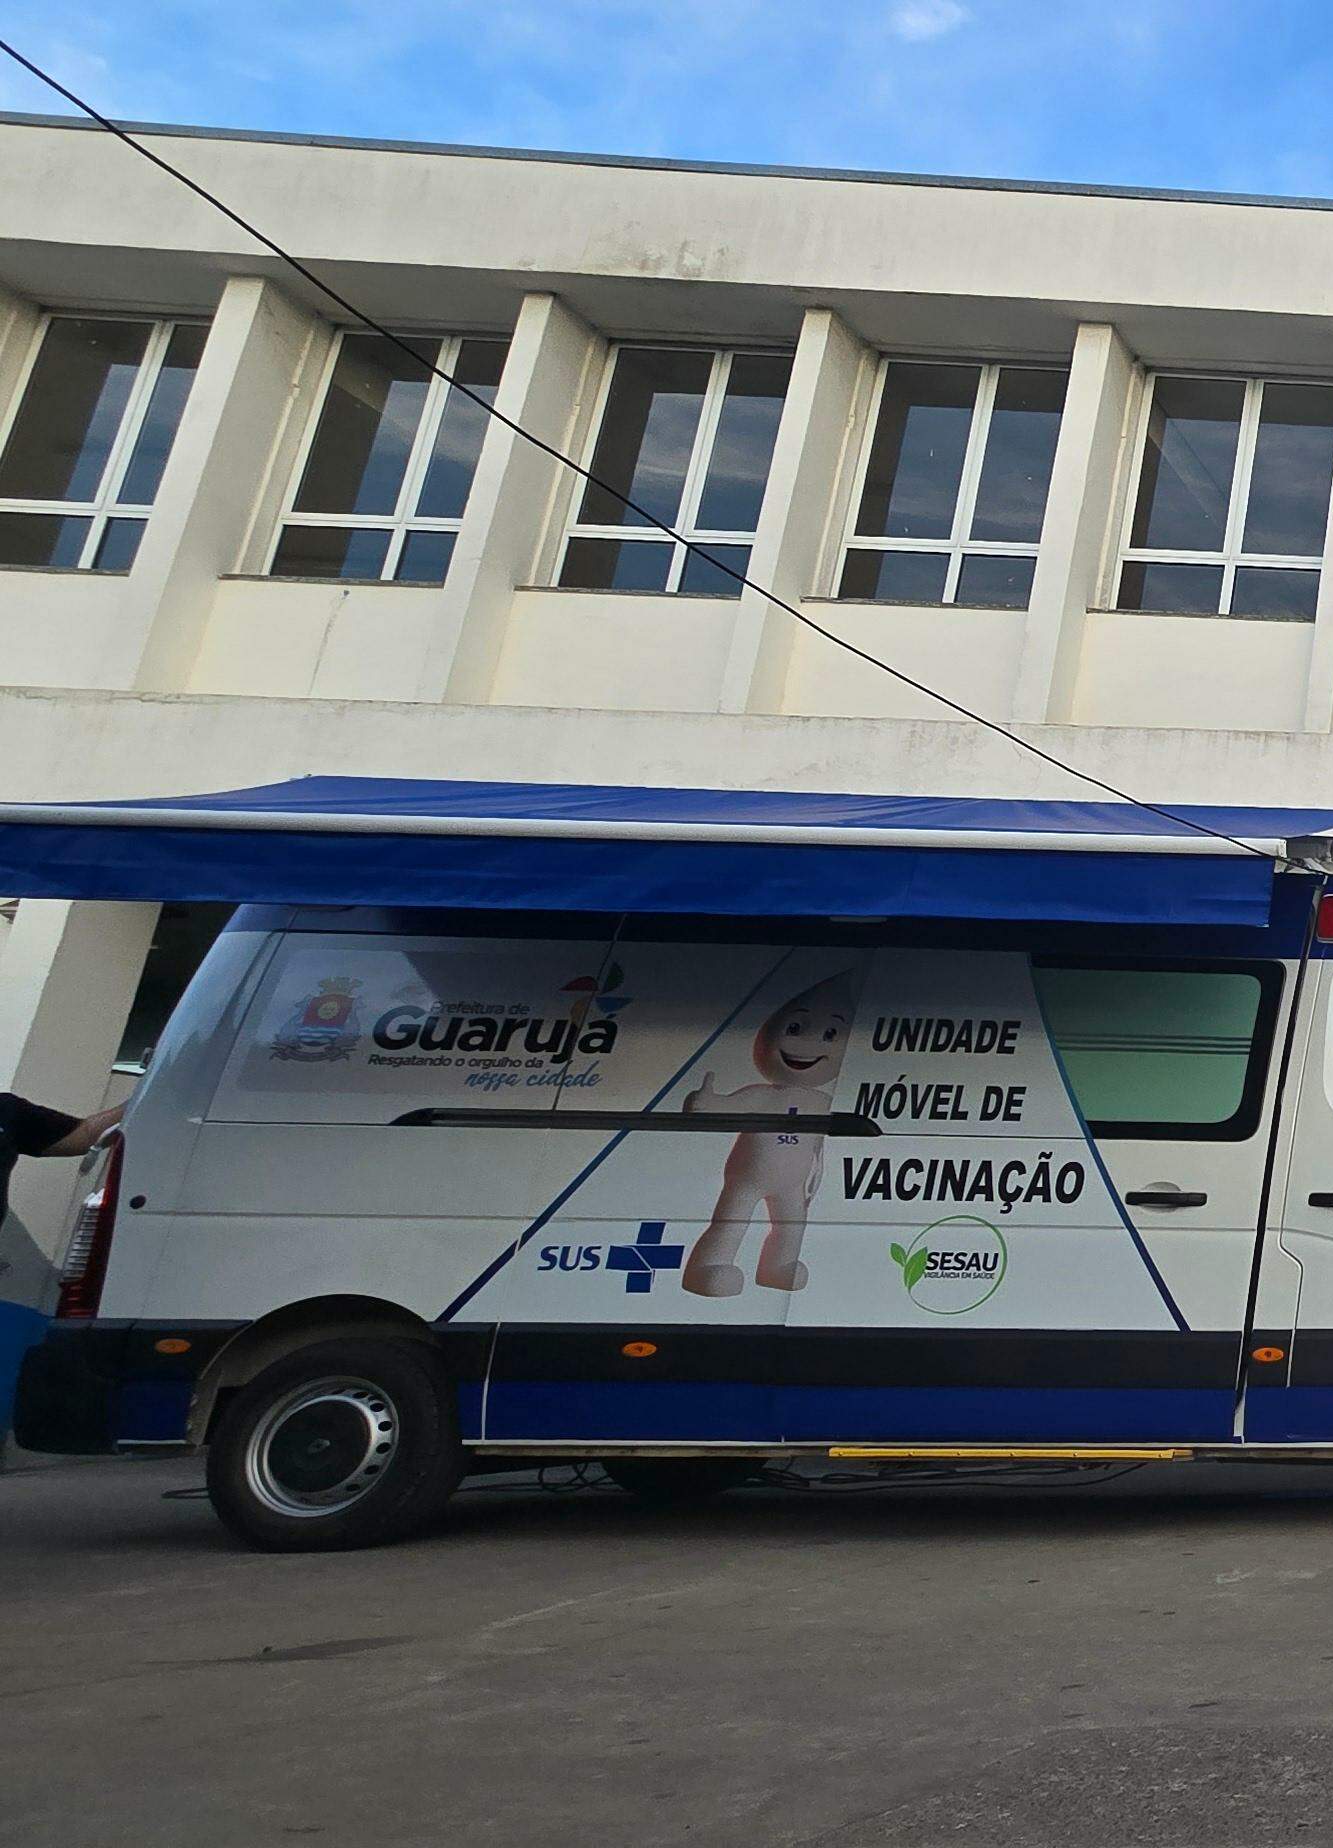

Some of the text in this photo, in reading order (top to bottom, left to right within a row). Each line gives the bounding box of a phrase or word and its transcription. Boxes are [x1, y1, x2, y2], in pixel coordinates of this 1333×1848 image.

[430, 1000, 531, 1015] Prefeitura de
[372, 1004, 619, 1064] Guarujá
[871, 1016, 1021, 1055] UNIDADE
[367, 1053, 545, 1070] Resgatando o orgulho da
[526, 1060, 604, 1088] cidade
[854, 1074, 1027, 1122] MÓVEL DE
[777, 1134, 799, 1145] SUS
[841, 1151, 1086, 1215] VACINAÇÃO
[537, 1244, 602, 1272] SUS
[925, 1251, 999, 1272] SESAU
